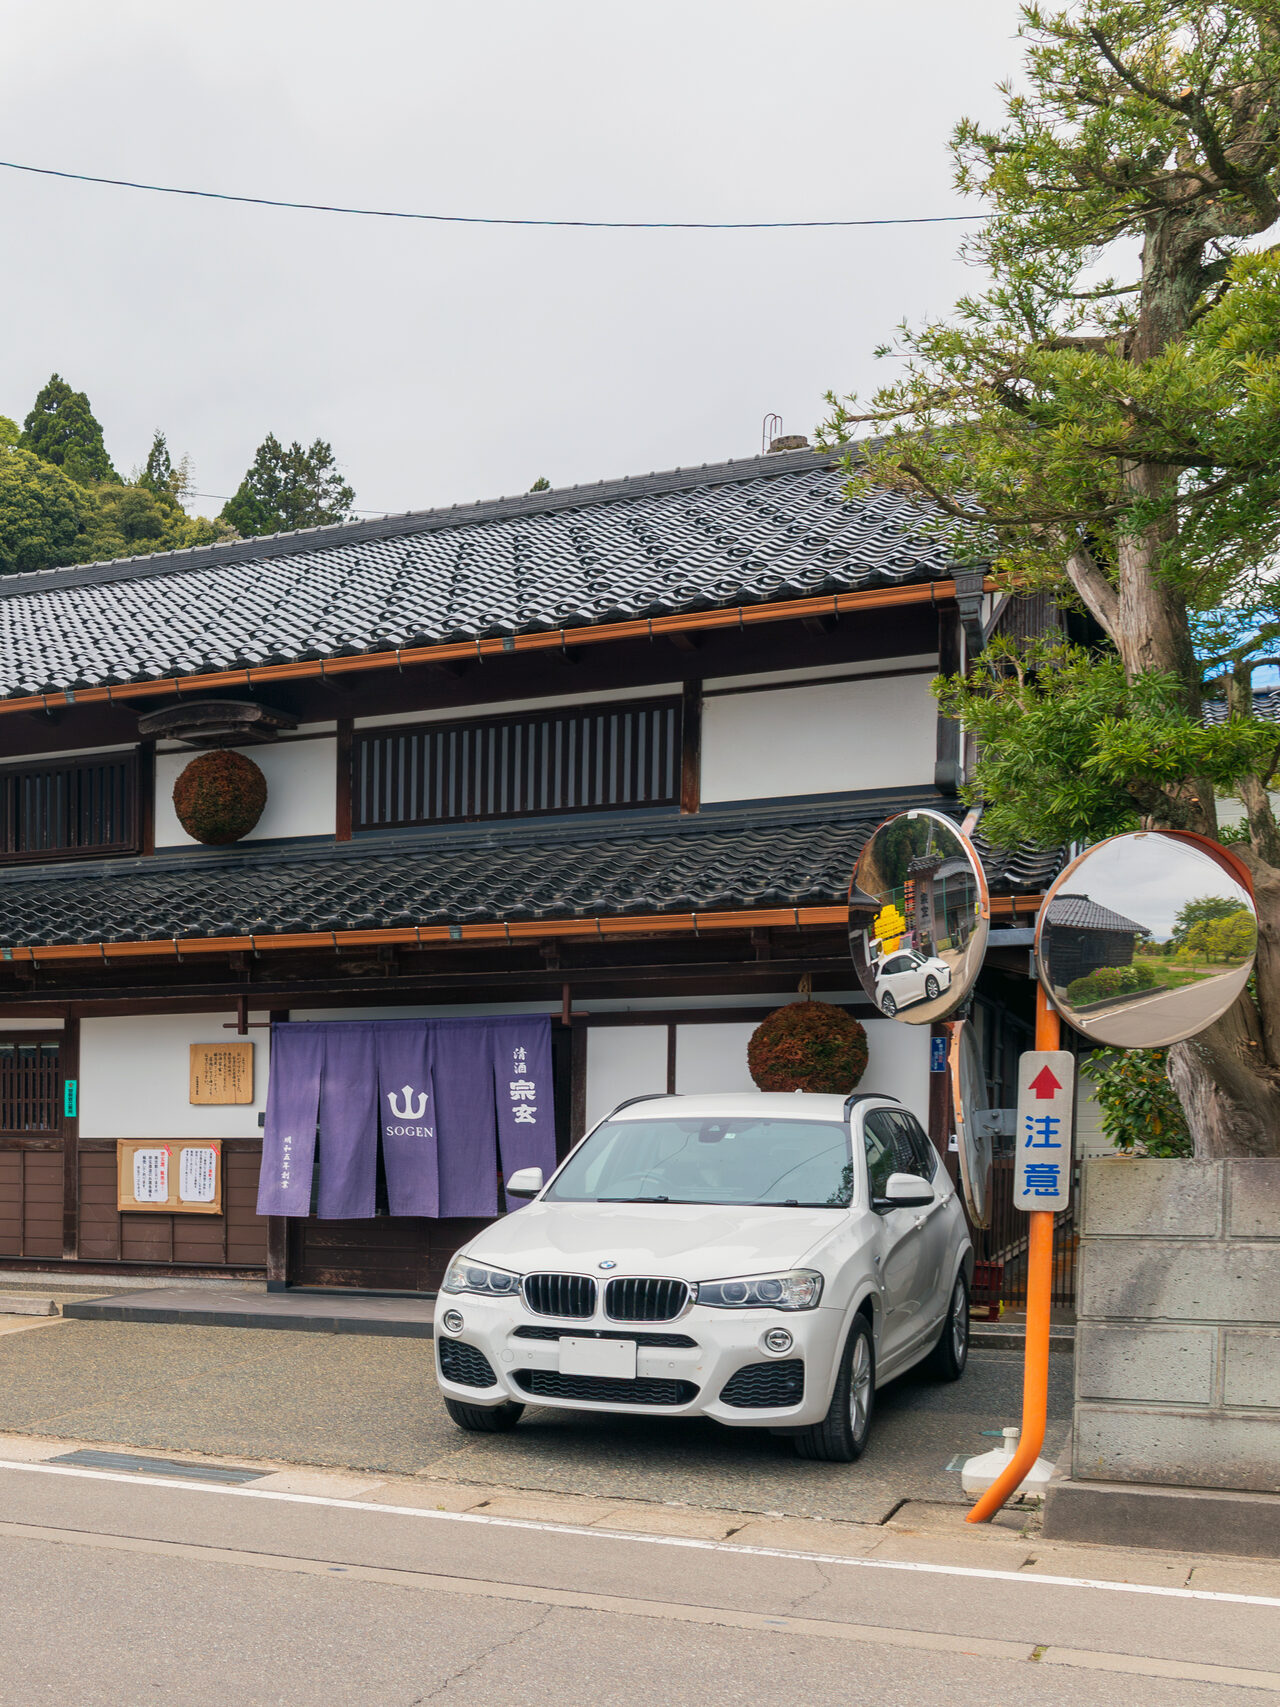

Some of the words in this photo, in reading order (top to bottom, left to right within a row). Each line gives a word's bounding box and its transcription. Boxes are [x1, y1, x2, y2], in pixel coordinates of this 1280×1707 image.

[386, 1125, 434, 1138] SOGEN
[1022, 1115, 1062, 1197] 注意
[280, 1136, 292, 1189] 明和五年創業
